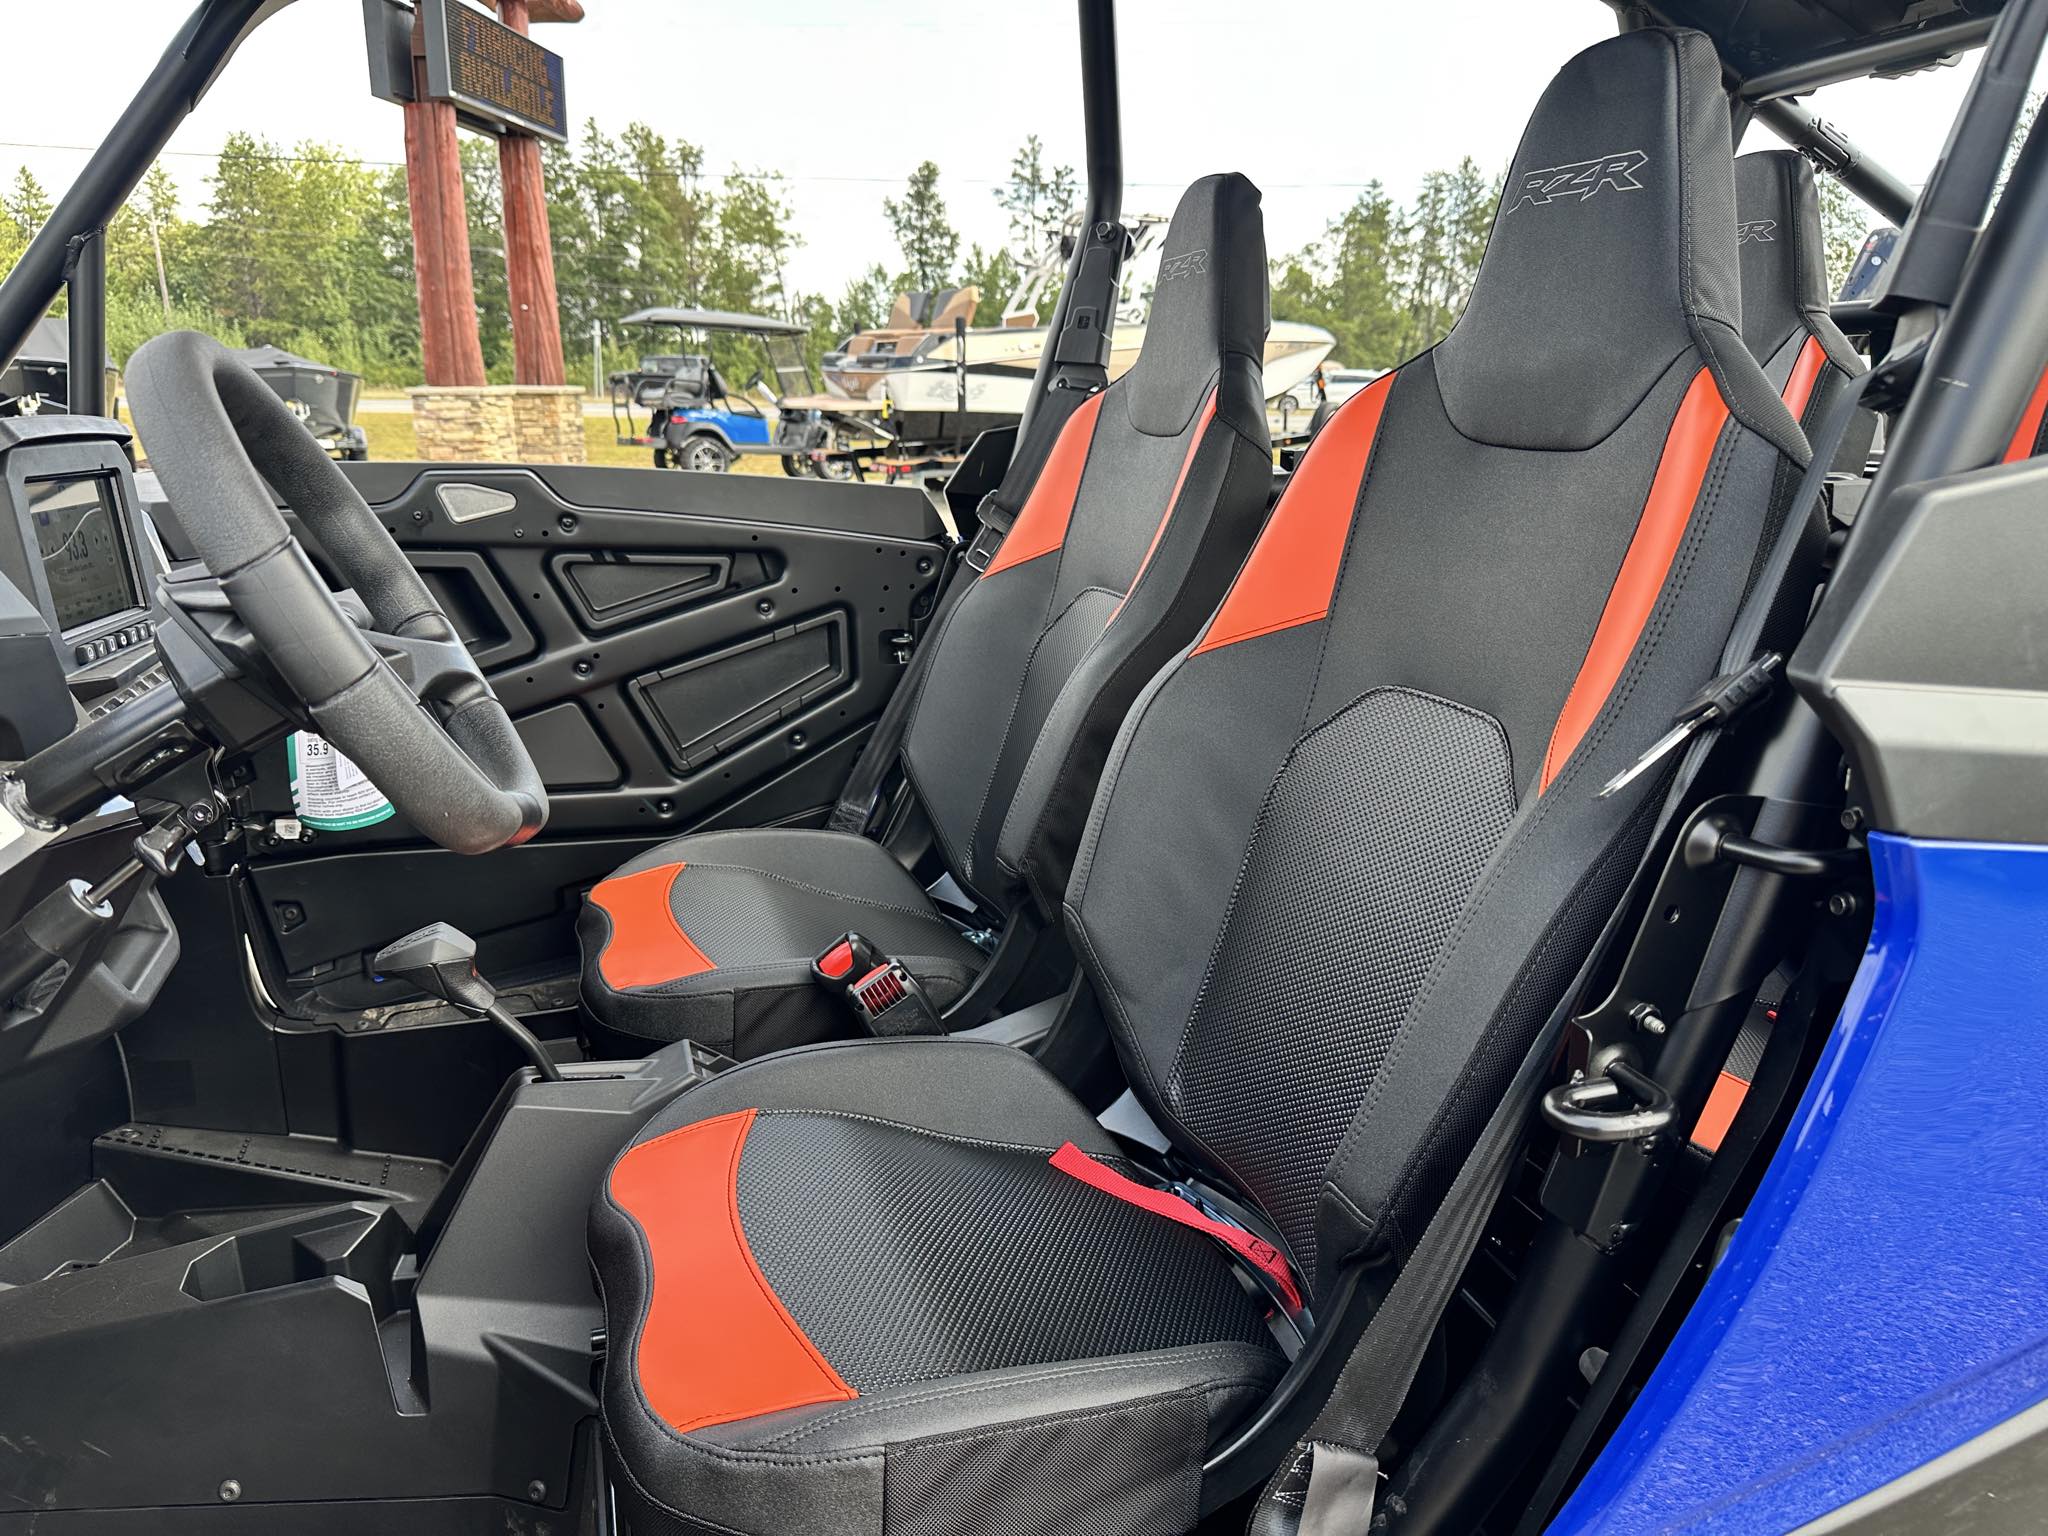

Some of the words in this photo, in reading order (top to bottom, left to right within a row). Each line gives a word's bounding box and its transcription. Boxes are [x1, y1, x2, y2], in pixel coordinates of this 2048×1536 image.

[460, 8, 548, 87] FINANCING
[459, 48, 556, 129] AVAILABLE
[1506, 149, 1649, 217] RZR
[1158, 248, 1208, 286] RZR
[306, 742, 329, 756] 35.9
